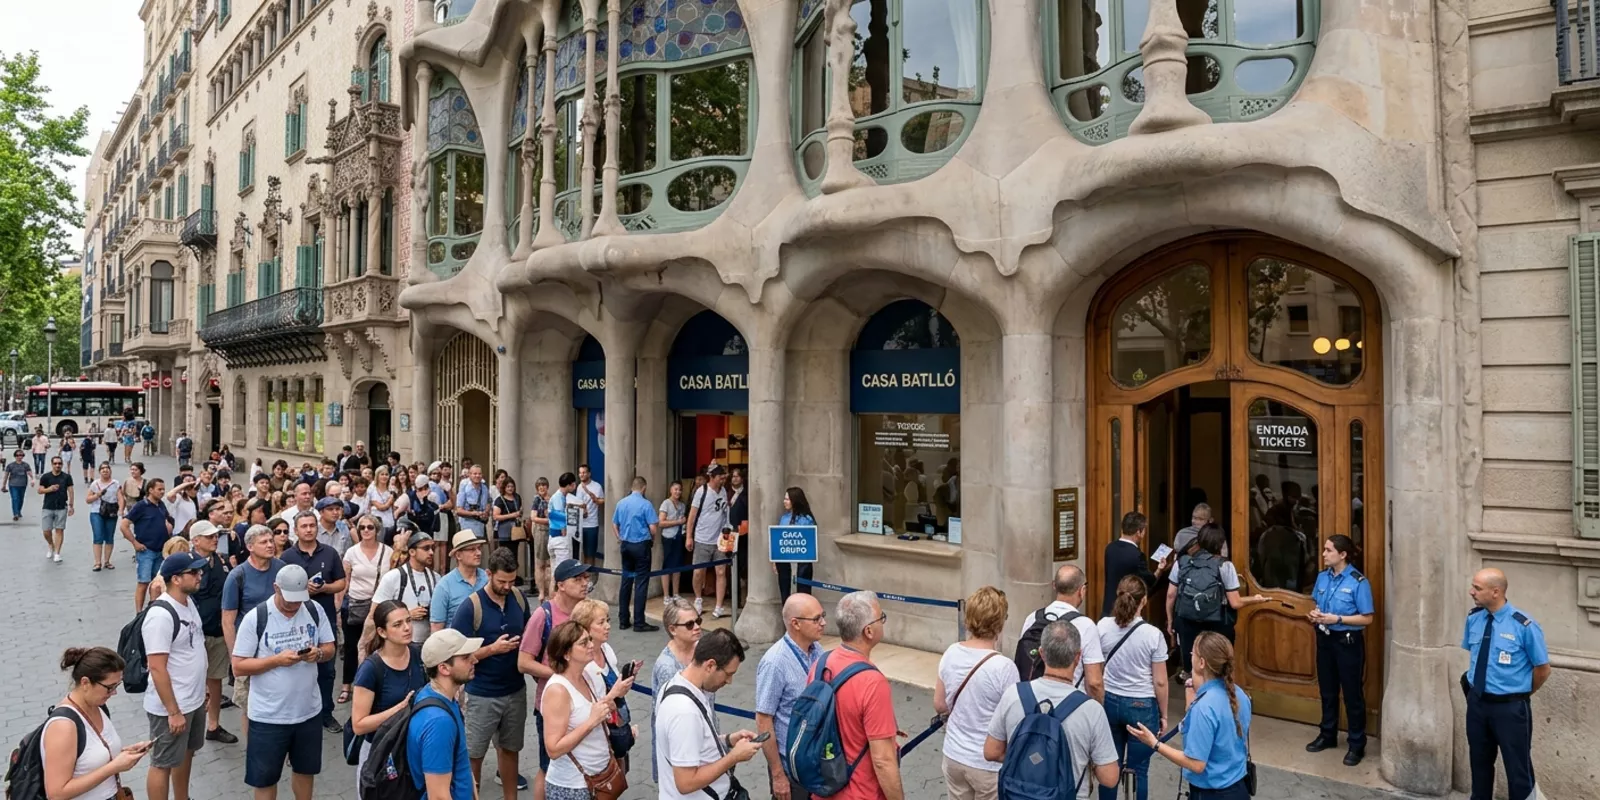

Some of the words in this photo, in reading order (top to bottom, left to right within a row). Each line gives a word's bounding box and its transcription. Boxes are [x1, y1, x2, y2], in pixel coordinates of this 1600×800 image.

[679, 375, 712, 390] CASA
[862, 374, 898, 387] CASA
[902, 370, 955, 387] BATLLÓ
[578, 379, 598, 390] CASA
[1256, 425, 1308, 435] ENTRADA
[1258, 437, 1306, 447] TICKETS
